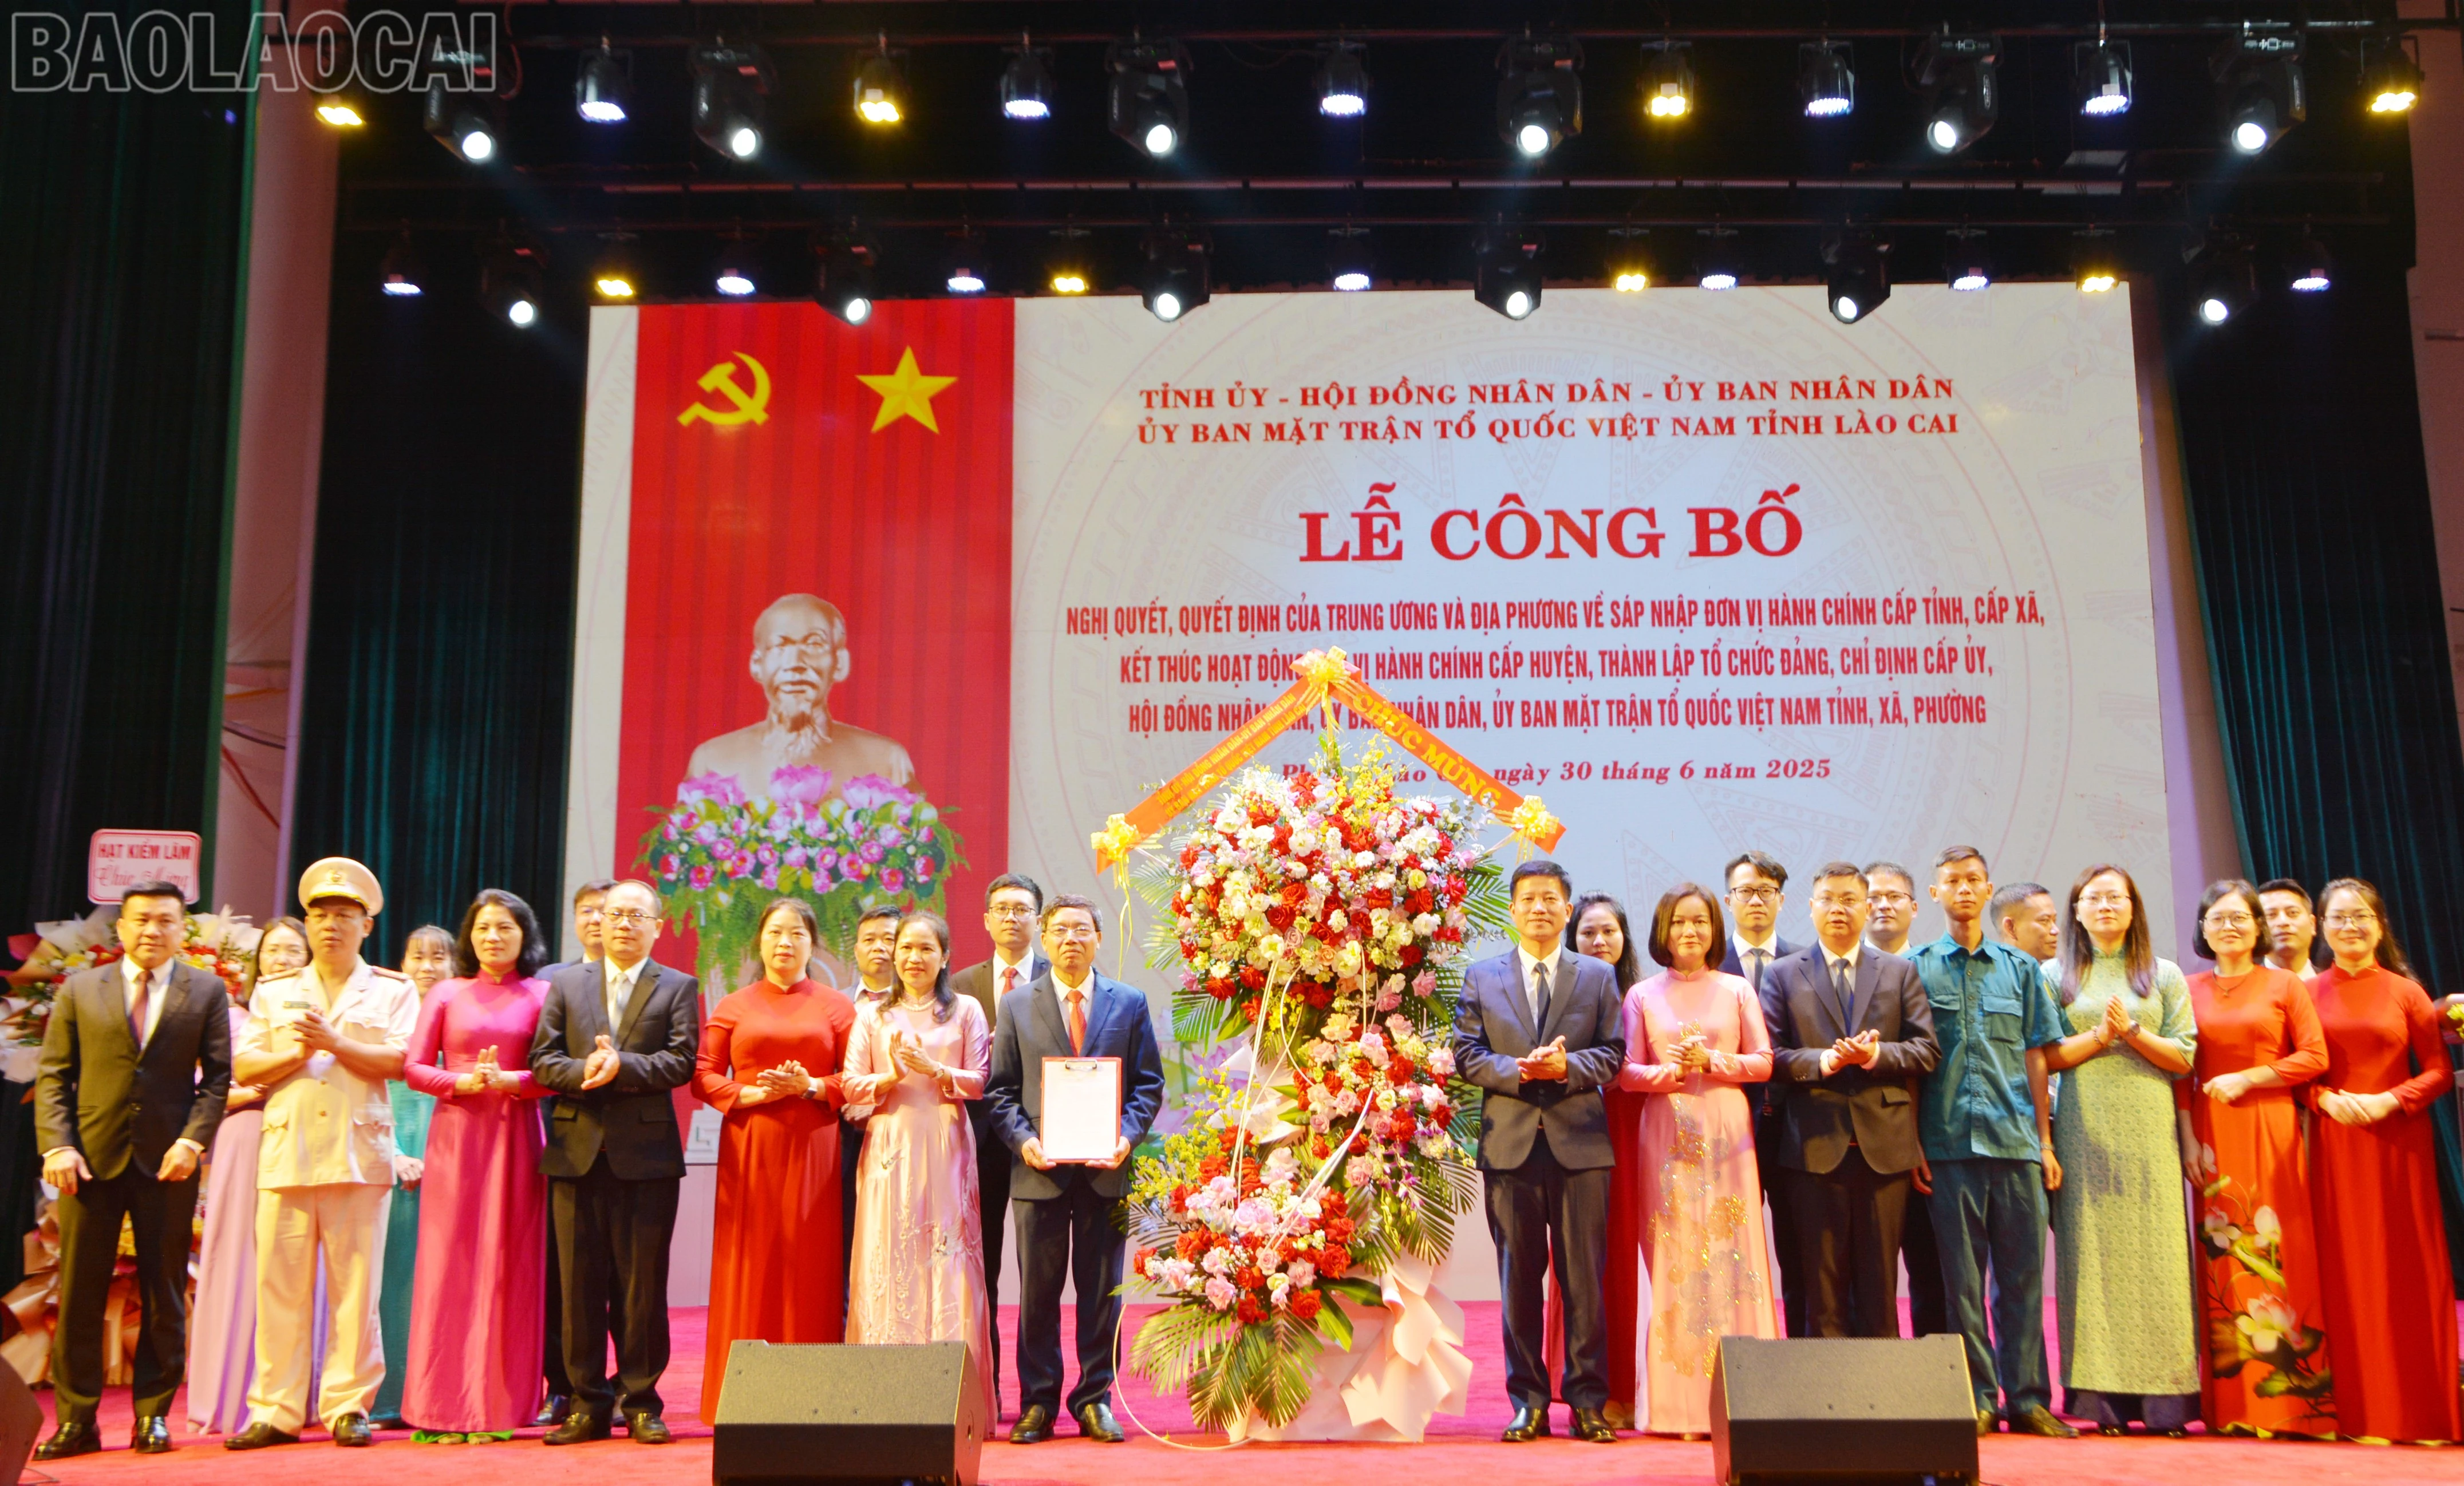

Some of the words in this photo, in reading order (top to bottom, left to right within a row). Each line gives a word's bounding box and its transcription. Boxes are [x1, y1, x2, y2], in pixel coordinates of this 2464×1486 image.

[1139, 382, 1215, 410] TỈNH
[1227, 380, 1268, 408] ỦY
[1300, 381, 1357, 411] HỘI
[1369, 376, 1456, 406] ĐỒNG
[1469, 378, 1554, 404] NHÂN
[1567, 377, 1630, 403] DÂN
[1664, 374, 1704, 402] ỦY
[1717, 380, 1778, 401] BAN
[1790, 374, 1876, 401] NHÂN
[1889, 373, 1953, 400] DÂN
[1138, 416, 1179, 445] ỦY
[1191, 422, 1251, 444] BAN
[1263, 417, 1329, 446] MẶT
[1338, 414, 1421, 444] TRẬN
[1434, 409, 1476, 440] TỔ
[1488, 410, 1575, 444] QUỐC
[1588, 412, 1660, 441] VIỆT
[1672, 416, 1735, 436] NAM
[1746, 408, 1823, 436] TỈNH
[1835, 409, 1898, 435] LÀO
[1907, 413, 1958, 434] CAI
[1298, 482, 1404, 563] LỄ
[1430, 492, 1666, 561] CÔNG
[1687, 483, 1803, 558] BỐ
[1067, 606, 1108, 641] NGHỊ
[1113, 596, 1173, 638] QUYẾT,
[1179, 595, 1233, 637] QUYẾT
[1237, 604, 1281, 639] ĐỊNH
[1286, 592, 1322, 633] CỦA
[1326, 603, 1384, 632] TRUNG
[1389, 601, 1438, 631] ƯƠNG
[1443, 596, 1466, 630] VÀ
[1470, 602, 1501, 635] ĐỊA
[1506, 599, 1578, 630] PHƯƠNG
[1583, 590, 1604, 629] VỀ
[1610, 594, 1645, 629] SÁP
[1650, 594, 1699, 633] NHẬP
[1704, 598, 1741, 627] ĐƠN
[1746, 599, 1763, 633] VỊ
[1768, 592, 1817, 627] HÀNH
[1822, 592, 1877, 626] CHÍNH
[1882, 587, 1917, 626] CẤP
[1921, 586, 1970, 627] TỈNH,
[1974, 586, 2010, 625] CẤP
[2015, 590, 2045, 626] XÃ,
[1120, 645, 1152, 684] KẾT
[1157, 650, 1202, 683] THÚC
[1207, 653, 1253, 688] HOẠT
[1375, 646, 1423, 680] HÀNH
[1429, 645, 1483, 680] CHÍNH
[1489, 641, 1524, 679] CẤP
[1530, 644, 1593, 684] HUYỆN,
[1598, 643, 1657, 677] THÀNH
[1662, 643, 1695, 683] LẬP
[1700, 638, 1722, 677] TỔ
[1727, 641, 1775, 677] CHỨC
[1780, 637, 1835, 677] ĐẢNG,
[1840, 637, 1870, 675] CHỈ
[1874, 646, 1918, 681] ĐỊNH
[1923, 637, 1959, 675] CẤP
[1964, 634, 1993, 676] ỦY,
[1128, 698, 1159, 739] HỘI
[1163, 695, 1213, 733] ĐỒNG
[1445, 695, 1487, 732] DÂN,
[1492, 689, 1515, 729] ỦY
[1521, 700, 1558, 728] BAN
[1563, 693, 1601, 733] MẶT
[1606, 693, 1653, 733] TRẬN
[1657, 687, 1679, 726] TỔ
[1685, 688, 1732, 729] QUỐC
[1737, 692, 1775, 732] VIỆT
[1780, 697, 1822, 725] NAM
[1826, 686, 1874, 726] TỈNH,
[1878, 690, 1909, 727] XÃ,
[1913, 688, 1987, 724] PHƯỜNG
[1209, 746, 1229, 764] NHÂN
[1250, 718, 1265, 732] BAN
[1263, 704, 1282, 722] NHÂN
[1280, 693, 1296, 708] DÂN
[1254, 732, 1270, 747] NAM
[1267, 721, 1284, 736] TỈNH
[1353, 693, 1423, 750] CHÚC
[1421, 744, 1501, 807] MỪNG
[1493, 763, 1550, 786] ngày
[1561, 762, 1592, 780] 30
[1602, 761, 1670, 784] tháng
[1680, 762, 1695, 779] 6
[1705, 764, 1755, 779] năm
[1766, 759, 1831, 778] 2025
